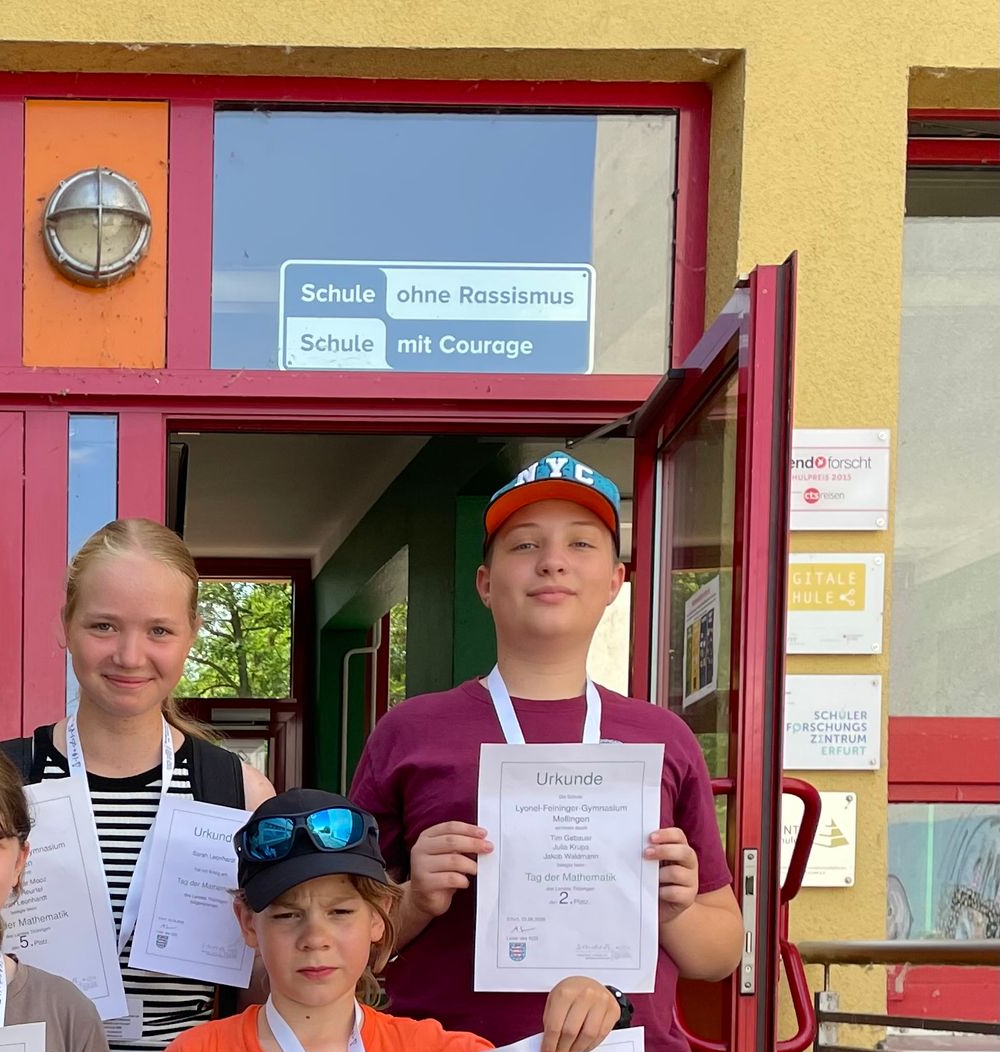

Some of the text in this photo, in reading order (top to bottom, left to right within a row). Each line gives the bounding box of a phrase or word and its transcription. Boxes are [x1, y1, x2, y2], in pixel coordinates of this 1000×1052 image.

[301, 283, 574, 305] Schule ohne Rassismus
[301, 334, 533, 359] Schule mit Courage
[828, 456, 872, 469] forscht
[514, 457, 594, 487] NYC
[814, 709, 867, 720] SCHÜLER
[786, 722, 867, 733] FORSCHUNGS
[821, 746, 867, 756] ERFURT
[536, 772, 603, 786] Urkunde
[194, 826, 233, 843] Urkund
[525, 872, 616, 883] Tag der Mathematik
[18, 910, 69, 928] Mathematik
